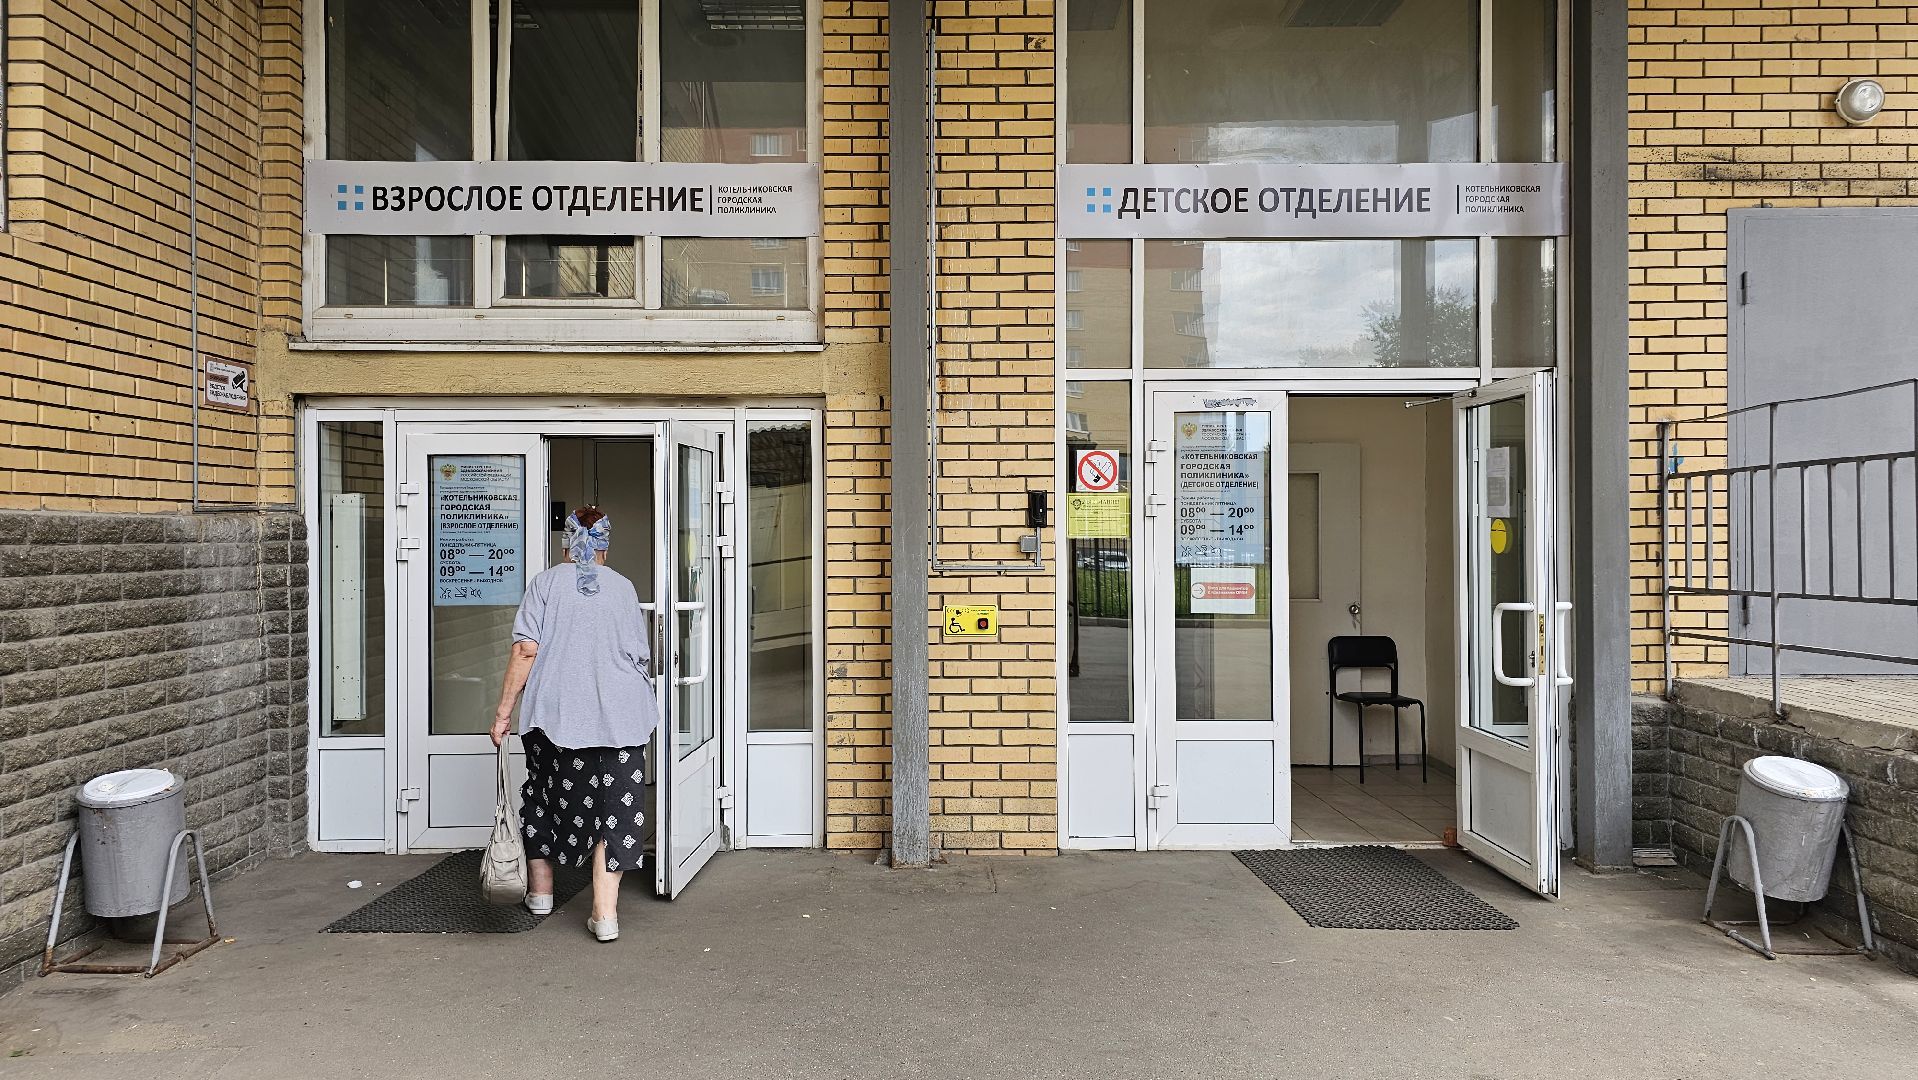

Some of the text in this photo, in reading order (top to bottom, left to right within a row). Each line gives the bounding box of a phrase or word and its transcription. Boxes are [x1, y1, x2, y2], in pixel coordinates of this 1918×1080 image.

[718, 185, 793, 194] КОТЕЛЬНИКОВСКАЯ
[1465, 185, 1541, 193] КОТЕЛЬНИКОВСКАЯ
[372, 185, 704, 216] ВЗРОСЛОЕ ОТДЕЛЕНИЕ
[717, 196, 762, 205] ГОРОДСКАЯ
[1118, 187, 1431, 220] ДЕТСКОЕ ОТДЕЛЕНИЕ
[1465, 196, 1510, 204] ГОРОДСКАЯ
[717, 206, 777, 214] ПОЛИКЛИНИКА
